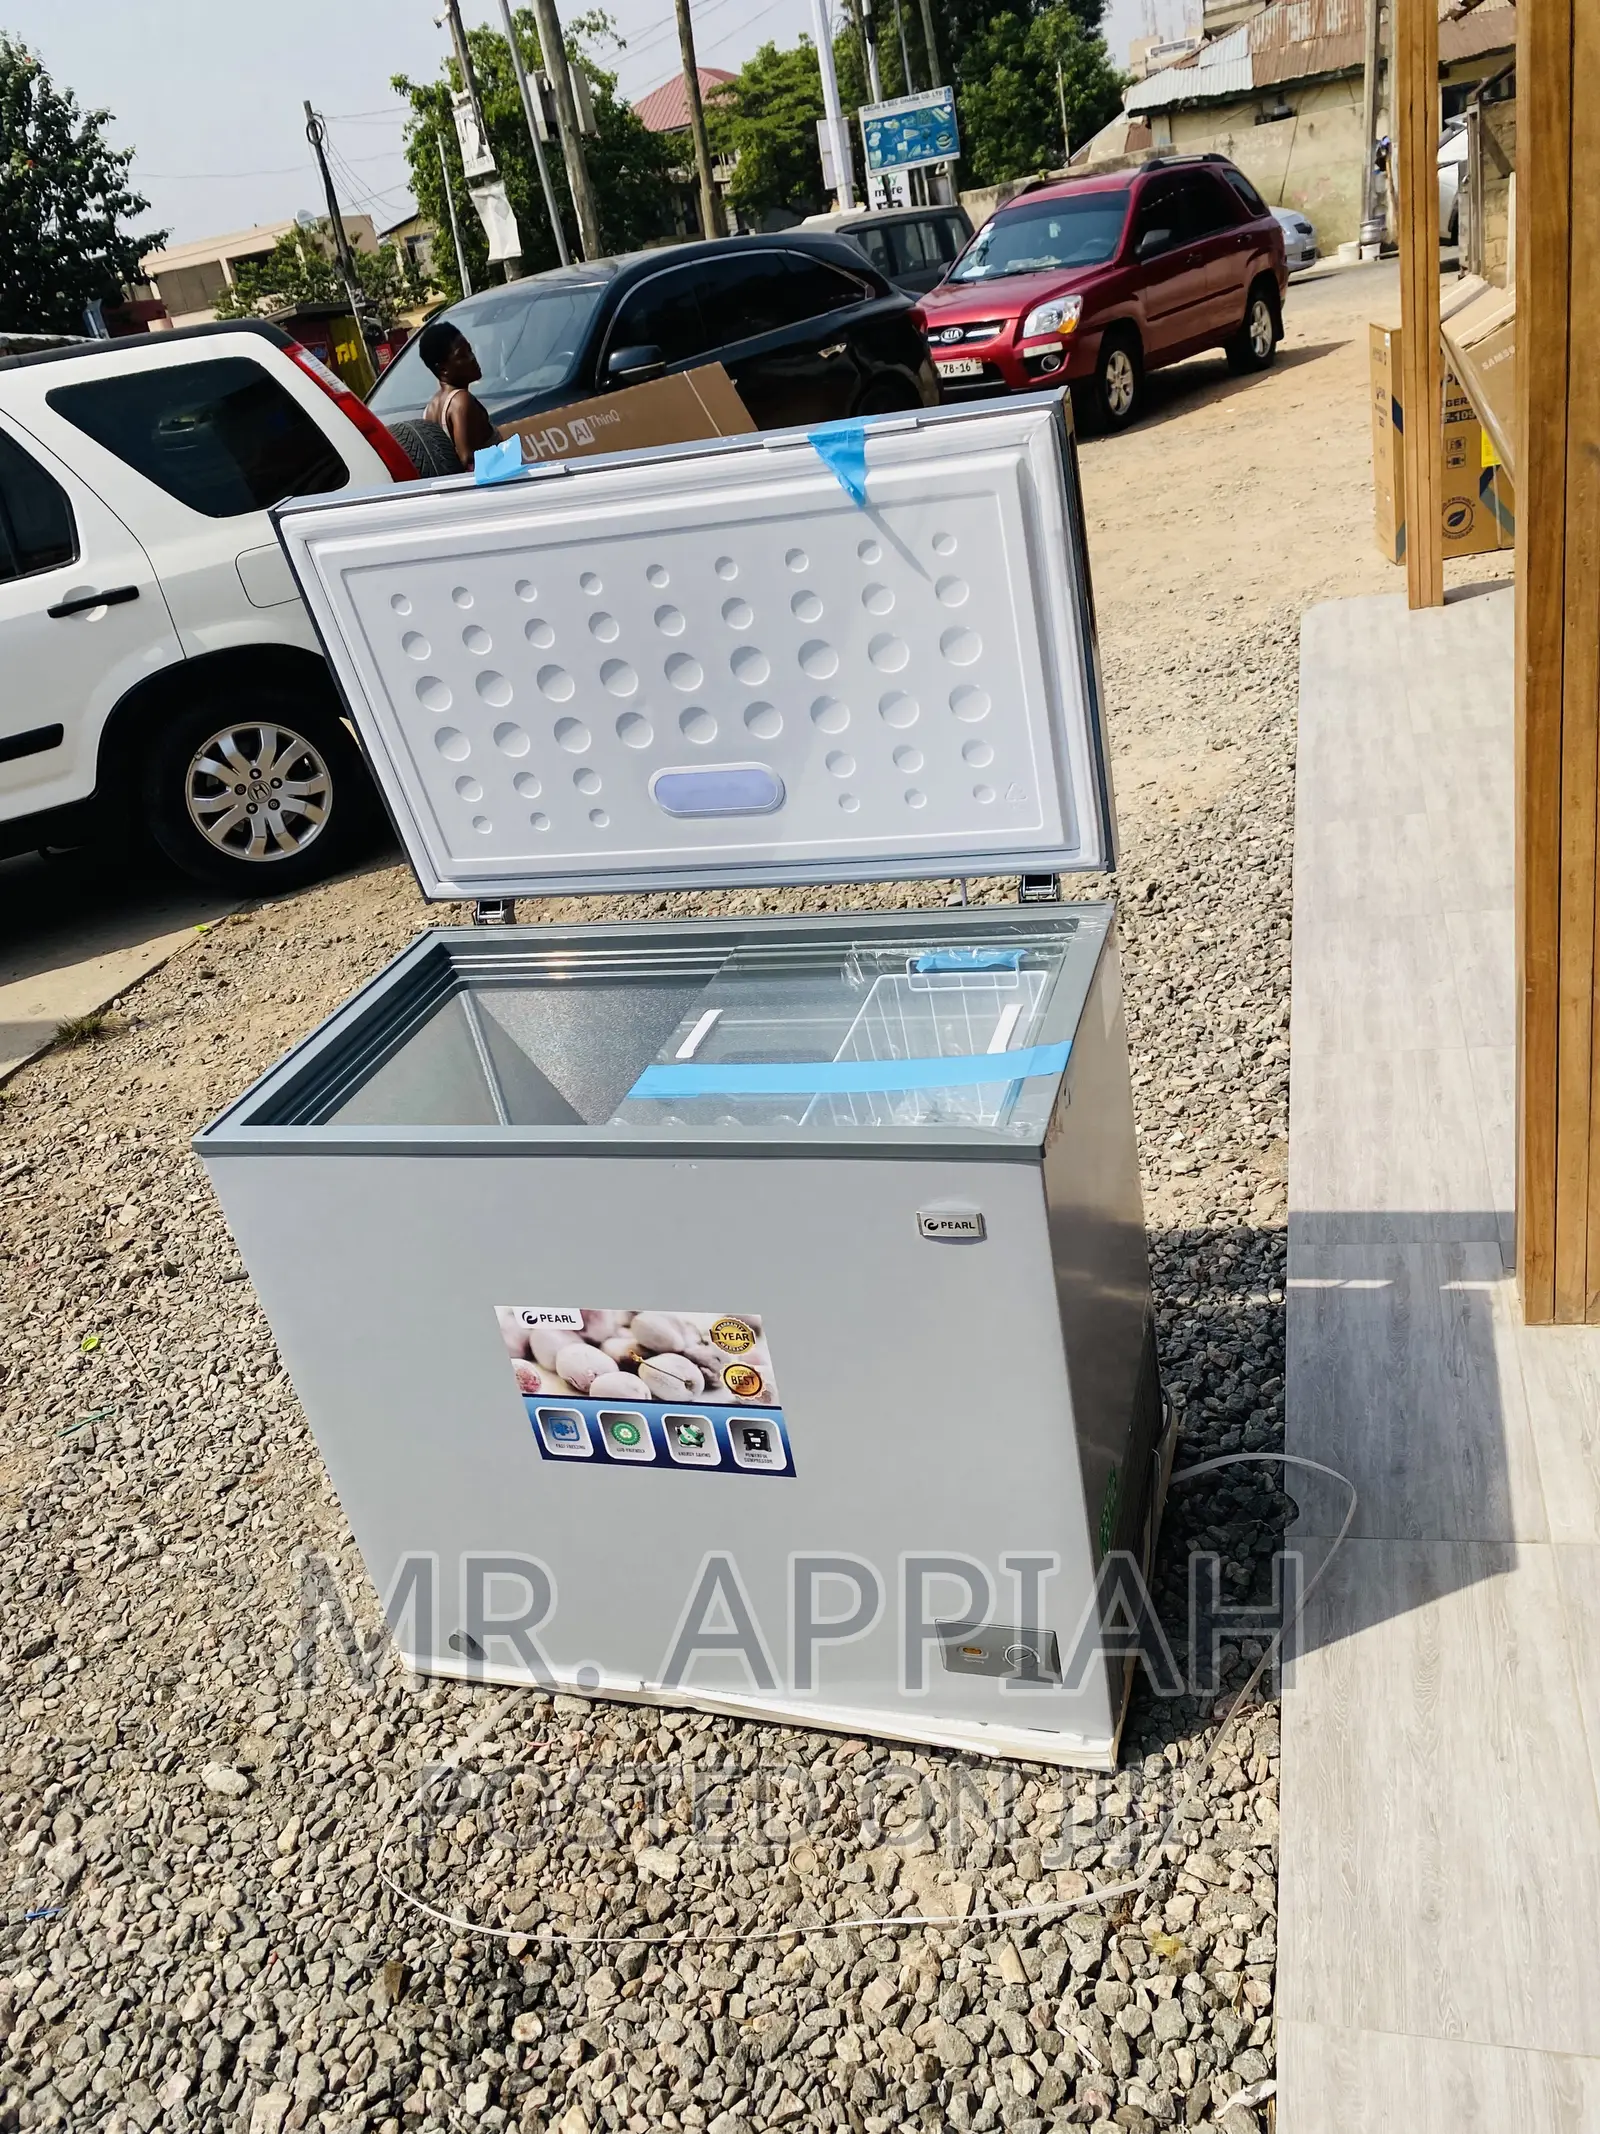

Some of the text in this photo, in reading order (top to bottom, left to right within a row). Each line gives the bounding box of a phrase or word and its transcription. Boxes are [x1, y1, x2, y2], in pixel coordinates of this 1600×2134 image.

[875, 186, 903, 197] mre
[1482, 345, 1515, 370] SAMSU
[587, 409, 620, 428] ThinQ
[941, 1221, 976, 1229] PEARL
[539, 1314, 576, 1324] PEARL
[721, 1332, 750, 1341] YEAR
[730, 1375, 755, 1386] BEST
